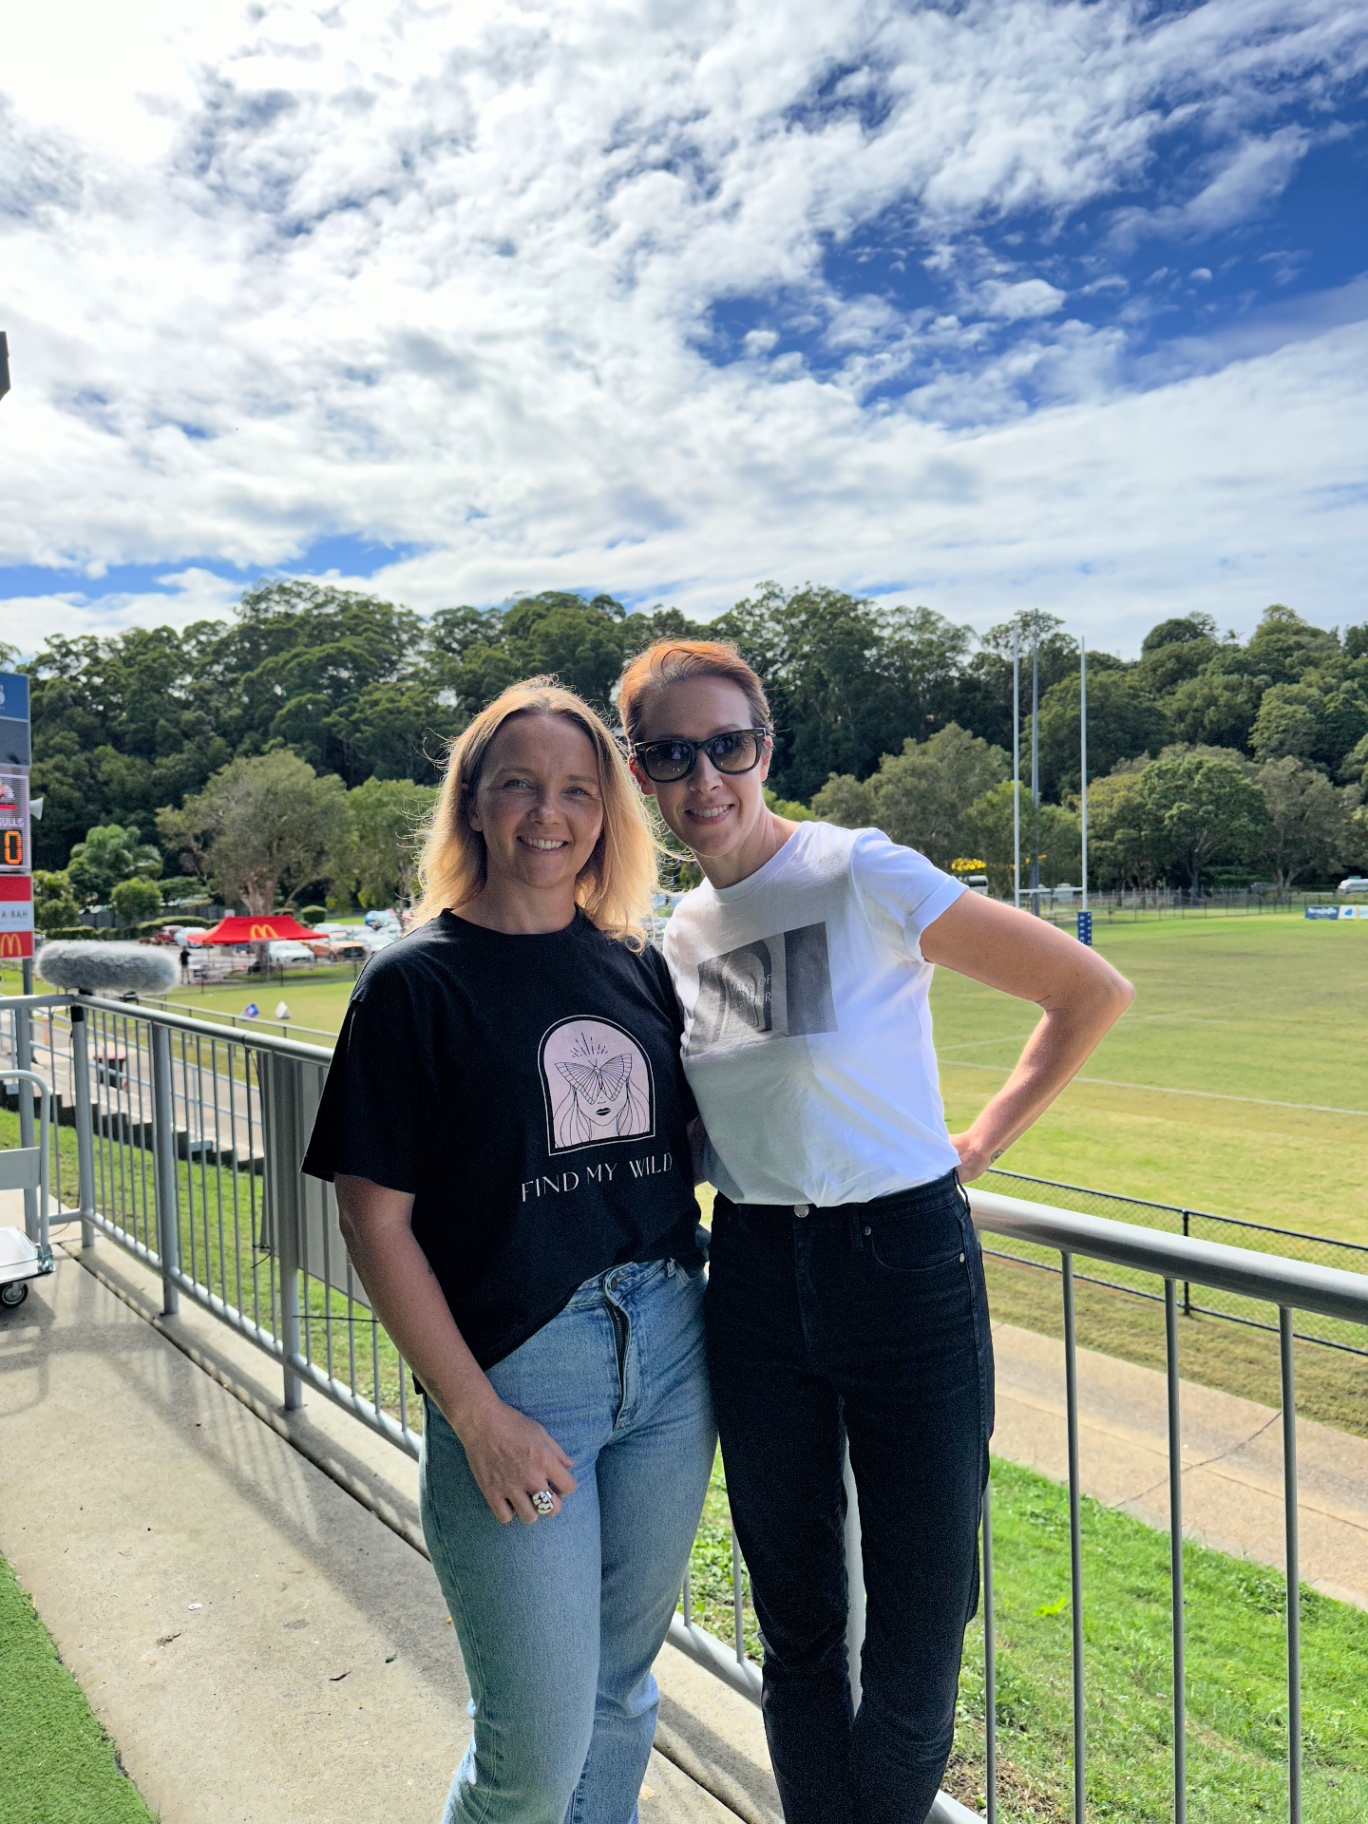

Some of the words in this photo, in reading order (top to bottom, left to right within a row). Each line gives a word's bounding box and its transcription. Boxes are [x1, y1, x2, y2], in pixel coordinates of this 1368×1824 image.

[4, 830, 22, 865] 0
[521, 1172, 580, 1202] FIND
[586, 1162, 618, 1186] MY
[629, 1152, 673, 1179] WILD
